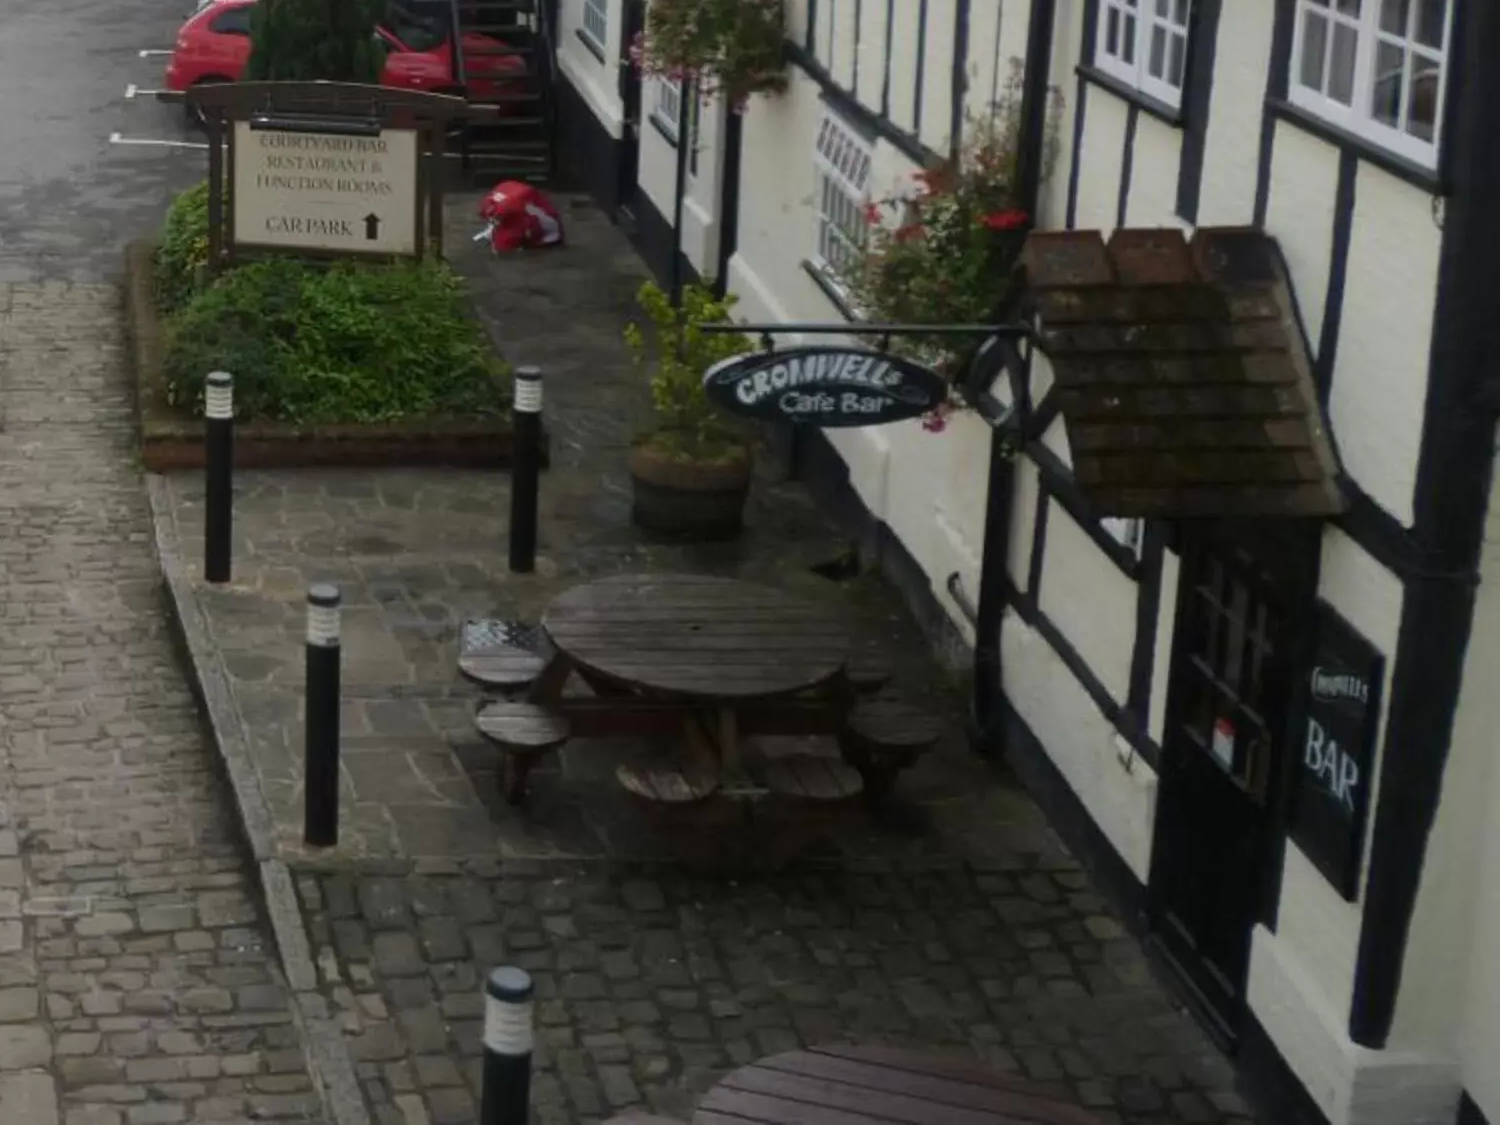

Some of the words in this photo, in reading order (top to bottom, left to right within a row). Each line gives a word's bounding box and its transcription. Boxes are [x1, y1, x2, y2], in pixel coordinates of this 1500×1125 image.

[266, 154, 366, 173] RESTAURANT
[257, 174, 334, 192] FUNCTION
[336, 178, 394, 196] ROOMS
[266, 216, 303, 234] CAR
[306, 217, 353, 236] PARK
[840, 392, 895, 414] Bar
[1304, 716, 1359, 812] BAR
